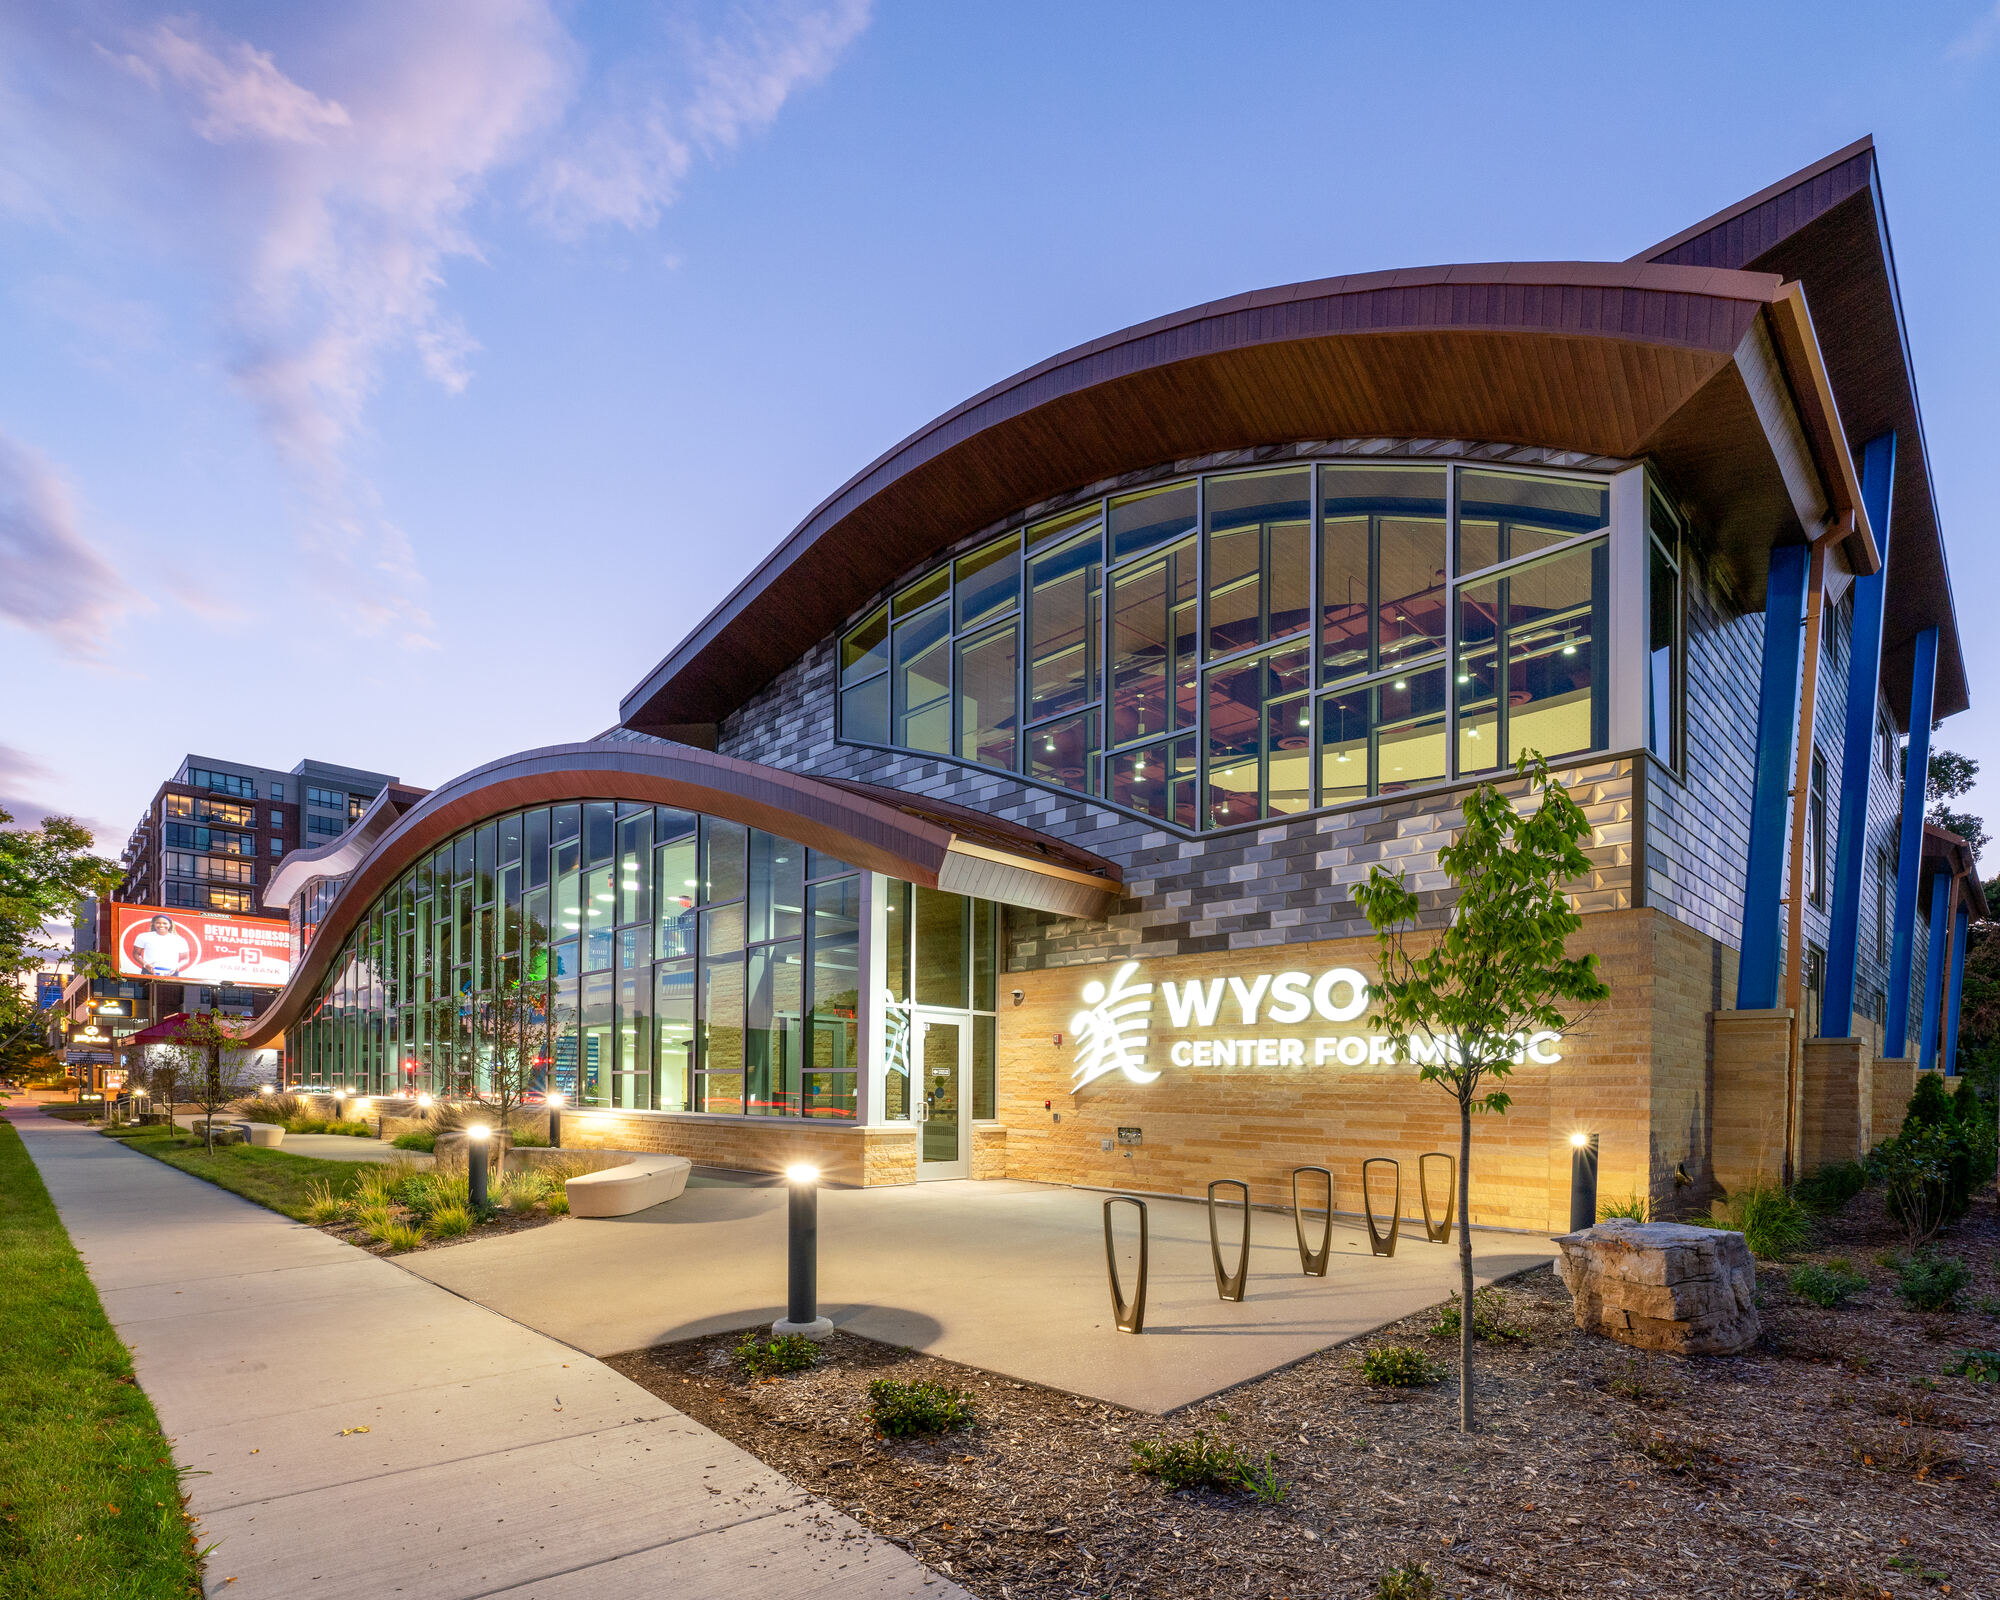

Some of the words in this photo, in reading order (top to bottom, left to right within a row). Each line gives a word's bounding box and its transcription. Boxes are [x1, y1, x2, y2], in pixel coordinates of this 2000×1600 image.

[204, 924, 239, 937] DEVYN
[241, 927, 290, 942] ROBINSON
[216, 936, 290, 948] TRANSFERRING
[220, 964, 247, 972] PARK
[253, 967, 280, 975] BANK
[1161, 968, 1369, 1027] WYSO
[1170, 1038, 1304, 1067] CENTER
[1314, 1036, 1398, 1066] FOR
